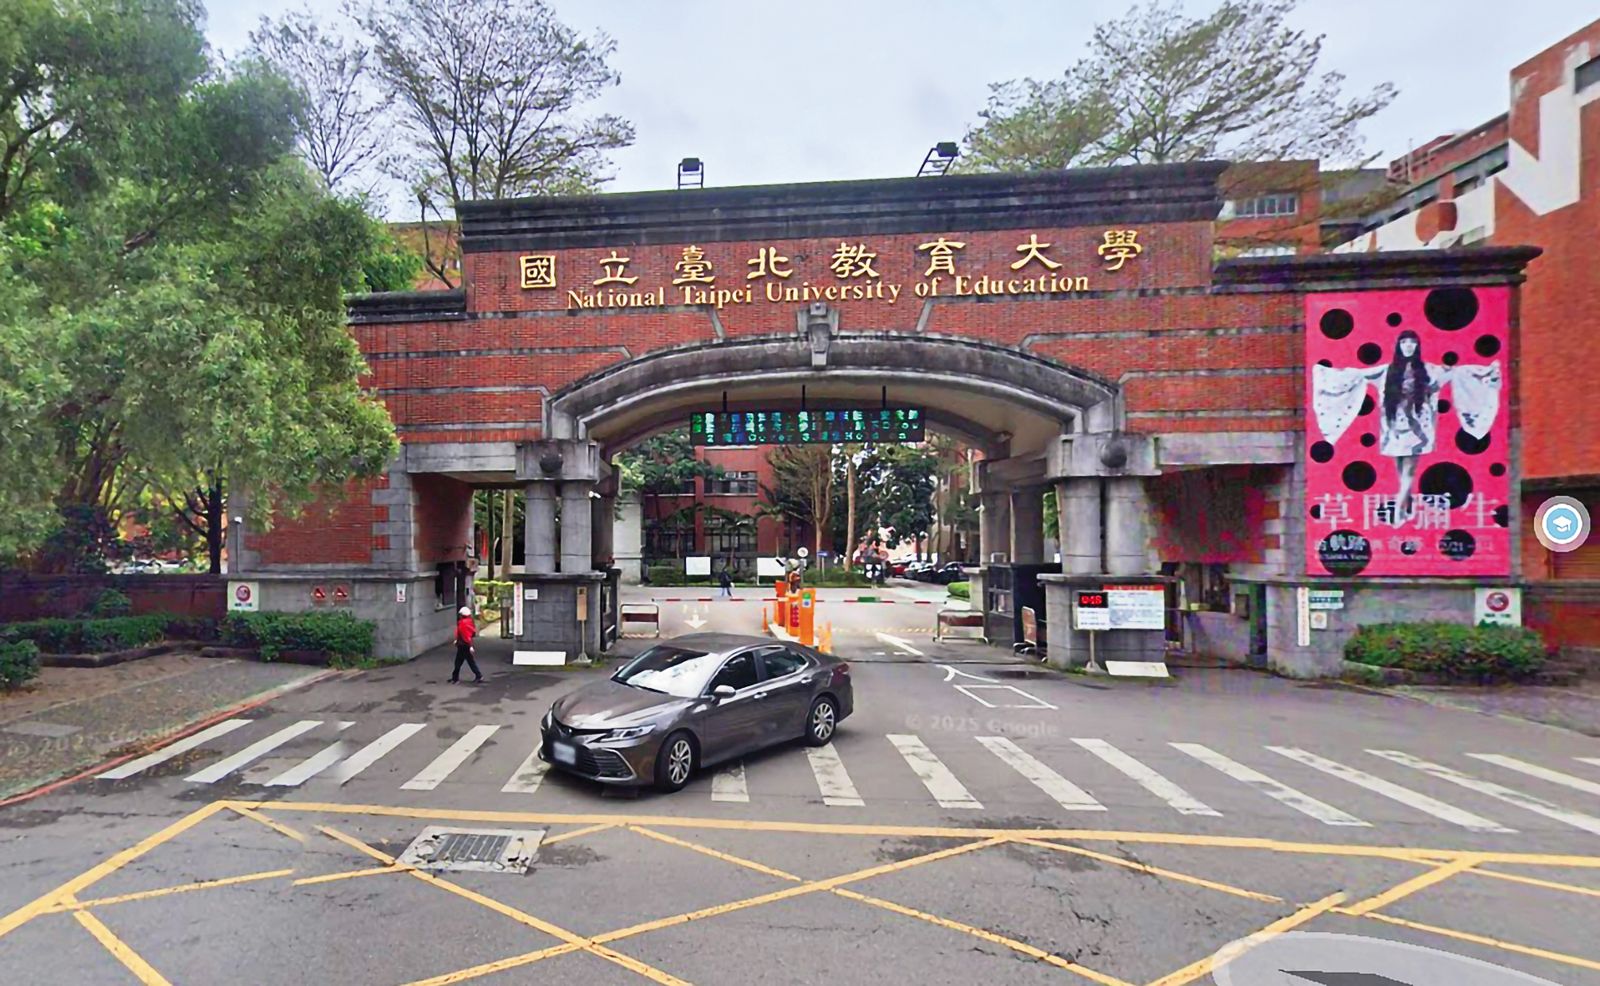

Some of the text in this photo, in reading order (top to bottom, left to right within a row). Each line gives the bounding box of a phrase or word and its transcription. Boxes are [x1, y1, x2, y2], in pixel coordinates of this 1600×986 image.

[519, 229, 1142, 289] 國立臺北教育大學
[567, 272, 1090, 309] National Taipei University of Education
